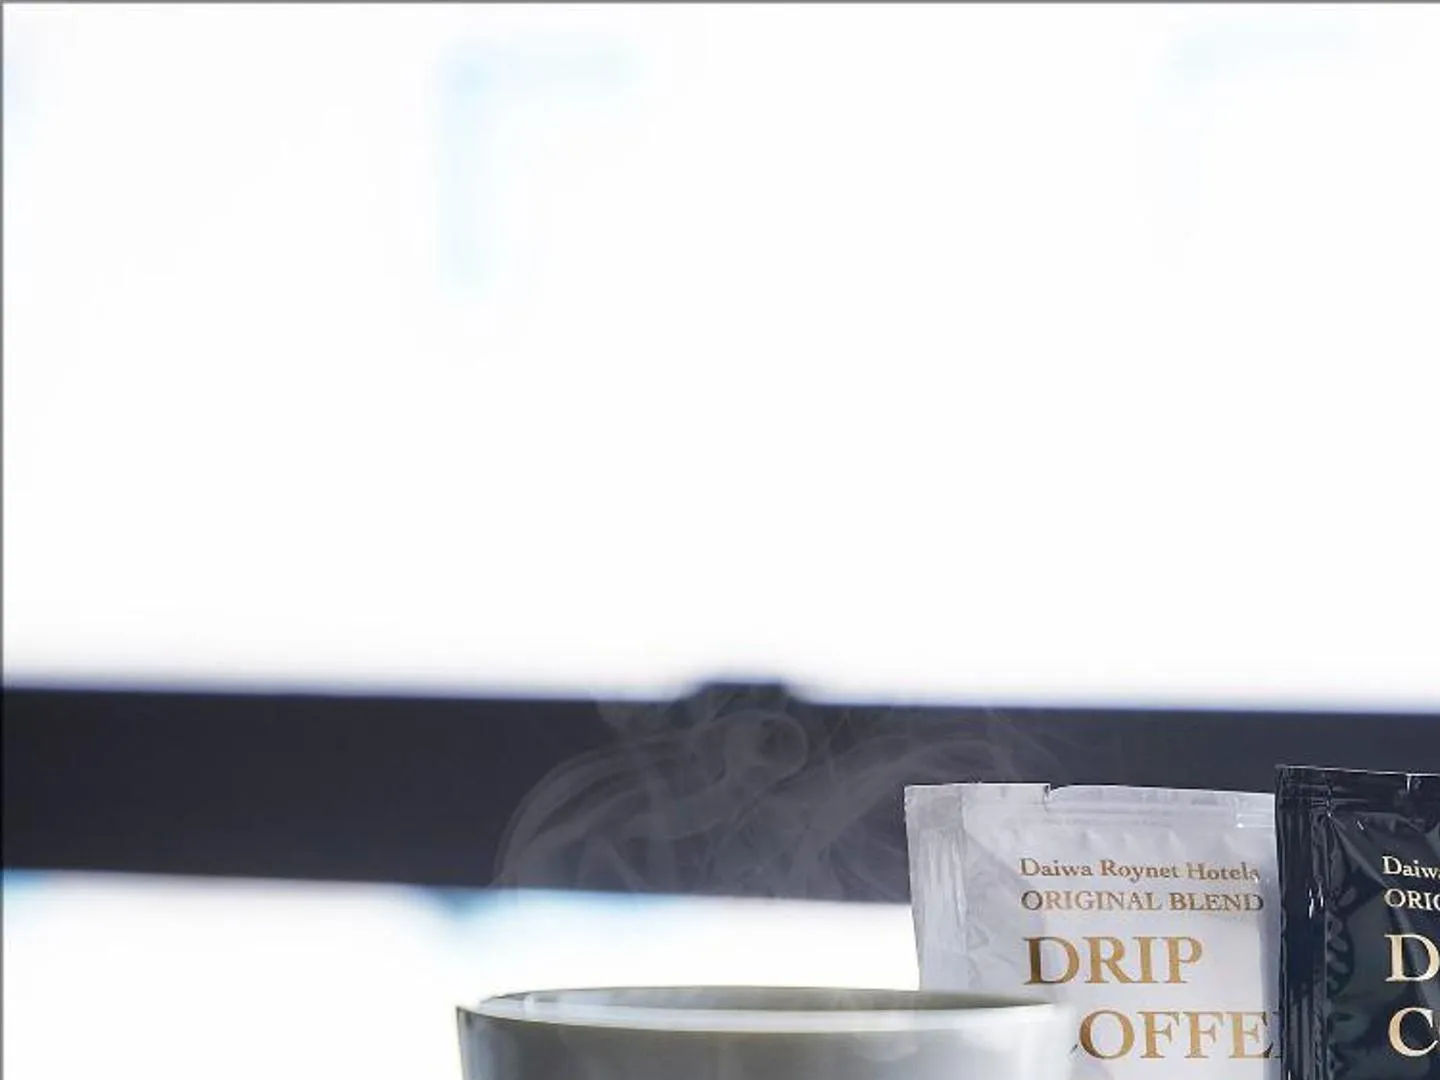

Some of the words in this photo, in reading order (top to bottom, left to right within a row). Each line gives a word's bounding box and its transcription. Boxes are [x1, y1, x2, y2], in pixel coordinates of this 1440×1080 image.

[1019, 857, 1092, 877] Daiwa
[1100, 859, 1179, 883] Roynet
[1187, 862, 1260, 882] Hotels
[1021, 889, 1162, 911] ORIGINAL
[1170, 891, 1264, 912] BLEND
[1022, 936, 1203, 986] DRIP
[1071, 1009, 1283, 1060] OFFE
